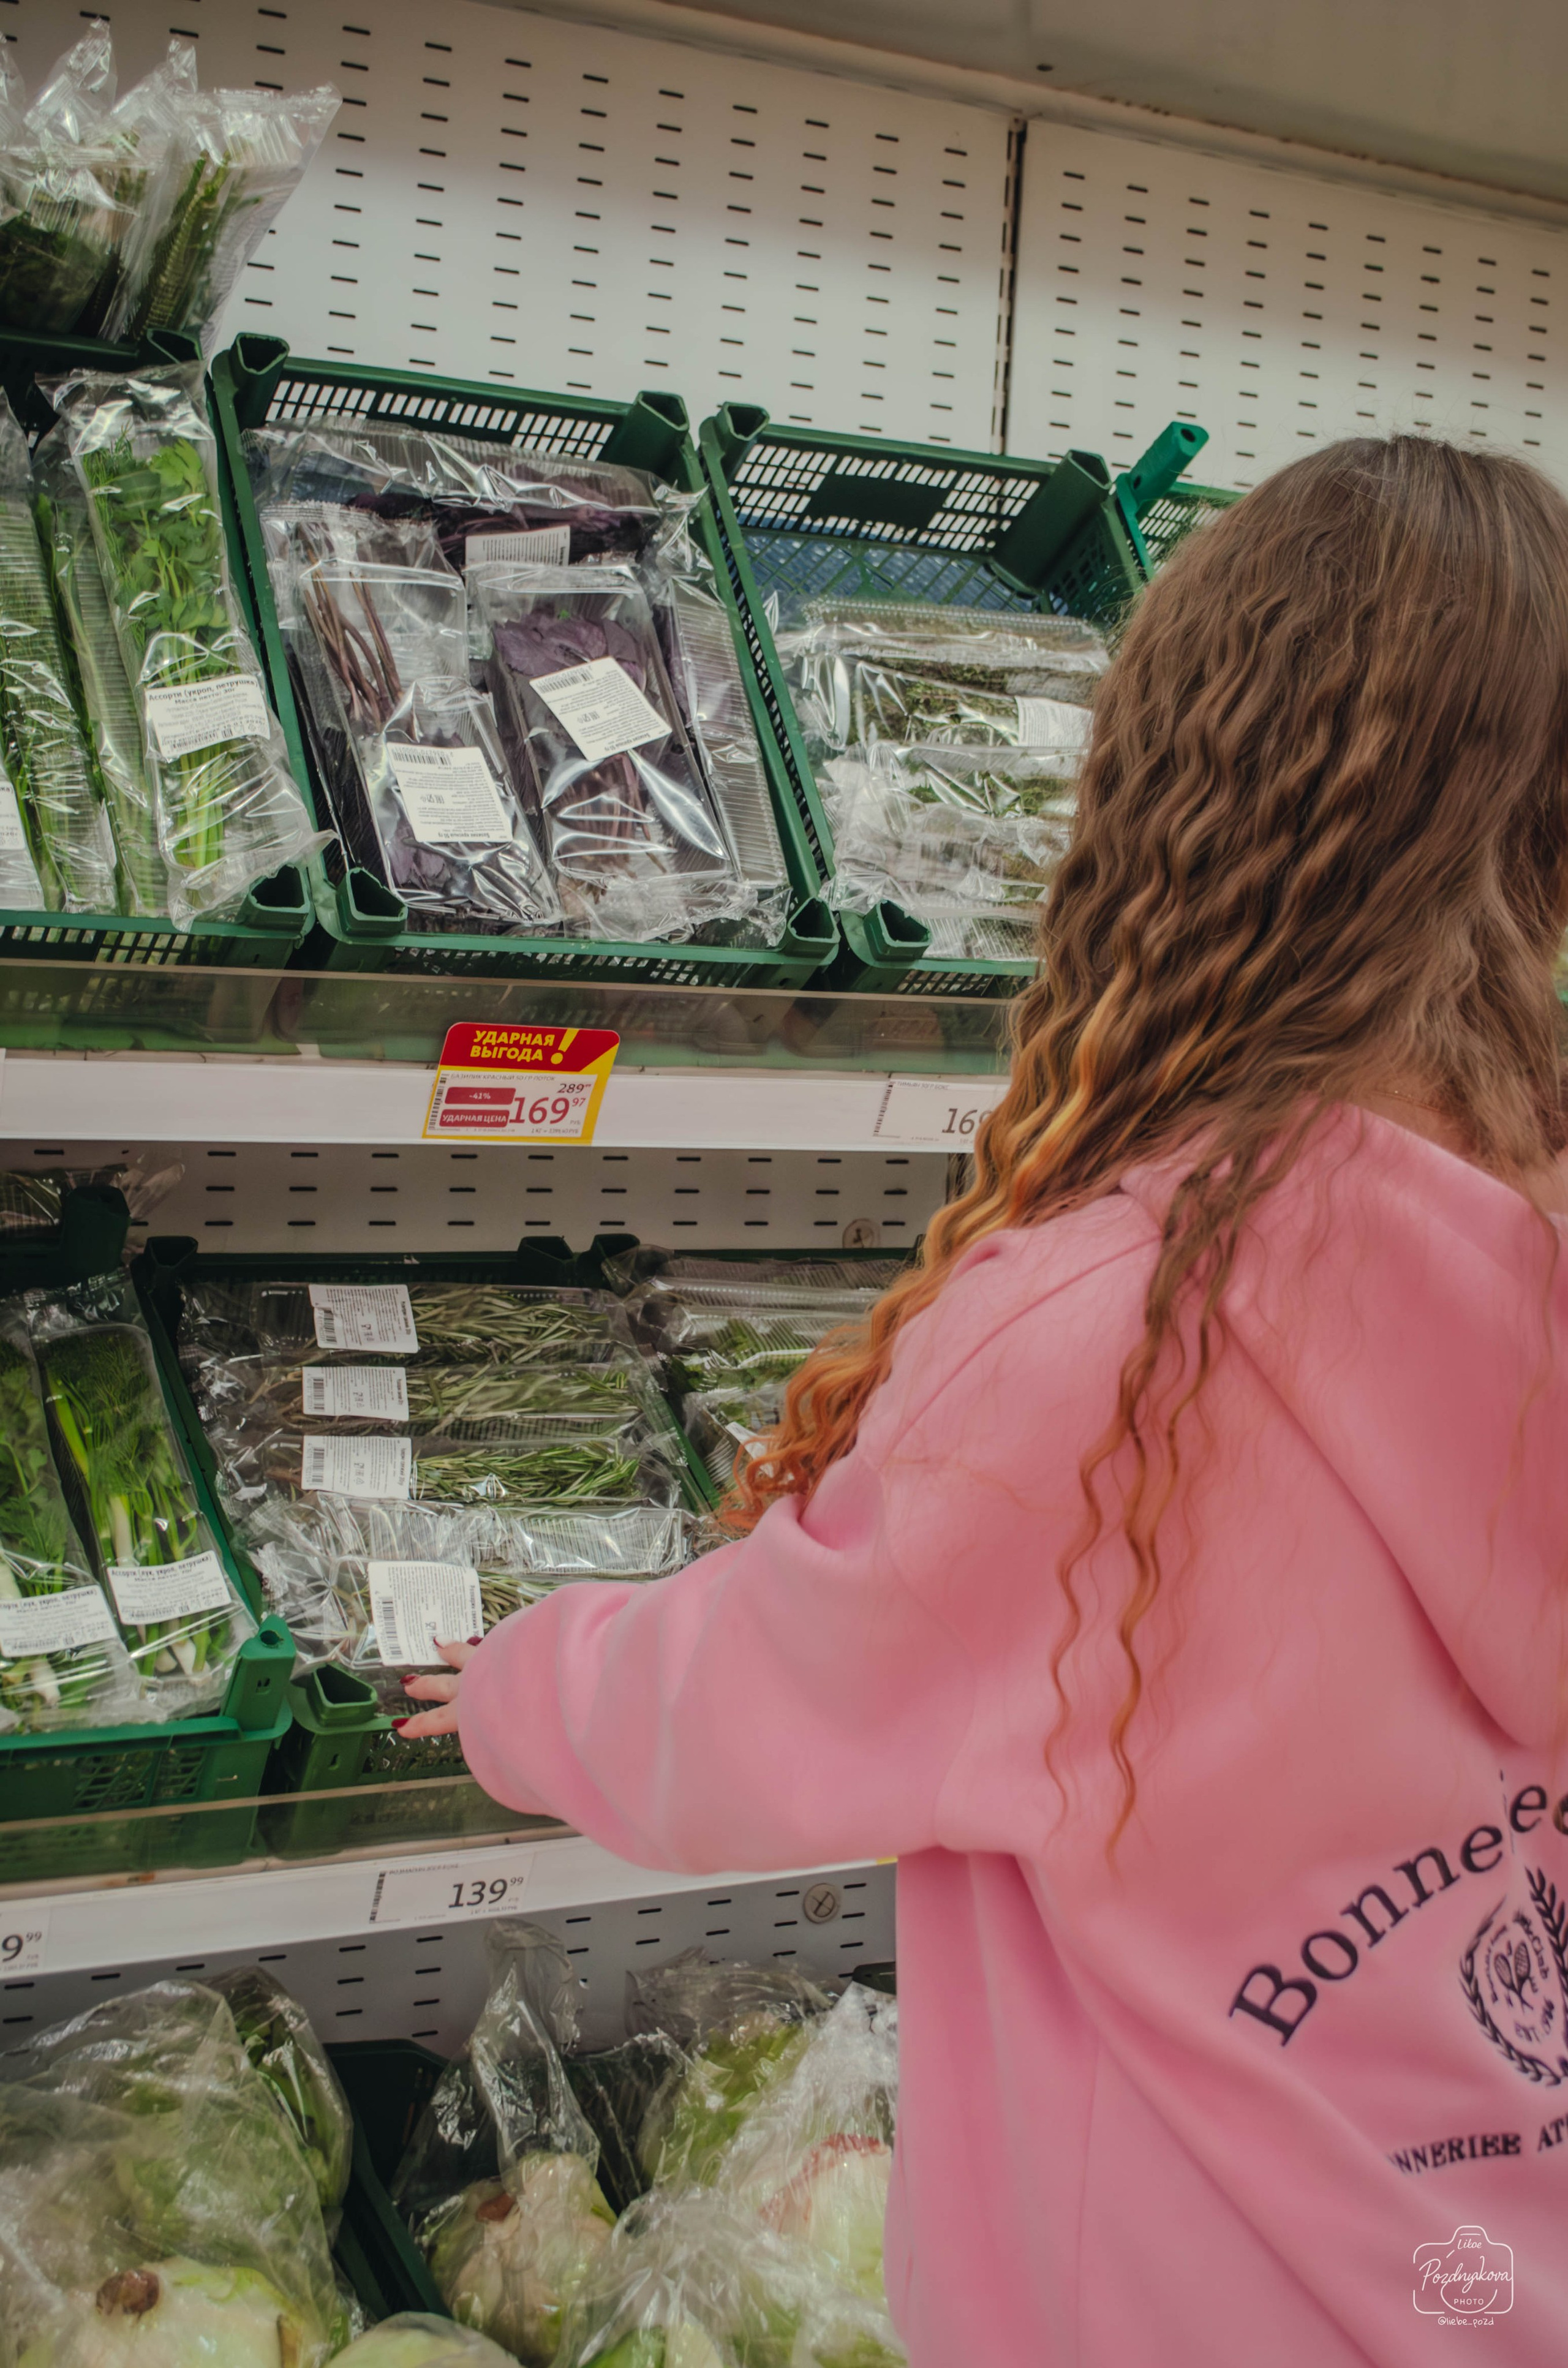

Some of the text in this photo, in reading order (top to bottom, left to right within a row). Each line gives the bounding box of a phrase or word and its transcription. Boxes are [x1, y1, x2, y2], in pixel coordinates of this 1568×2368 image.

[473, 1030, 556, 1047] УДАРНАЯ
[470, 1045, 543, 1063] ВЫГОДА
[469, 1092, 491, 1100] -41%
[443, 1114, 507, 1123] УДАРНАЯ ЦЕНА
[509, 1096, 570, 1125] 169
[448, 1876, 524, 1909] 139 99
[26, 1931, 42, 1943] 99
[1536, 2113, 1568, 2152] AT
